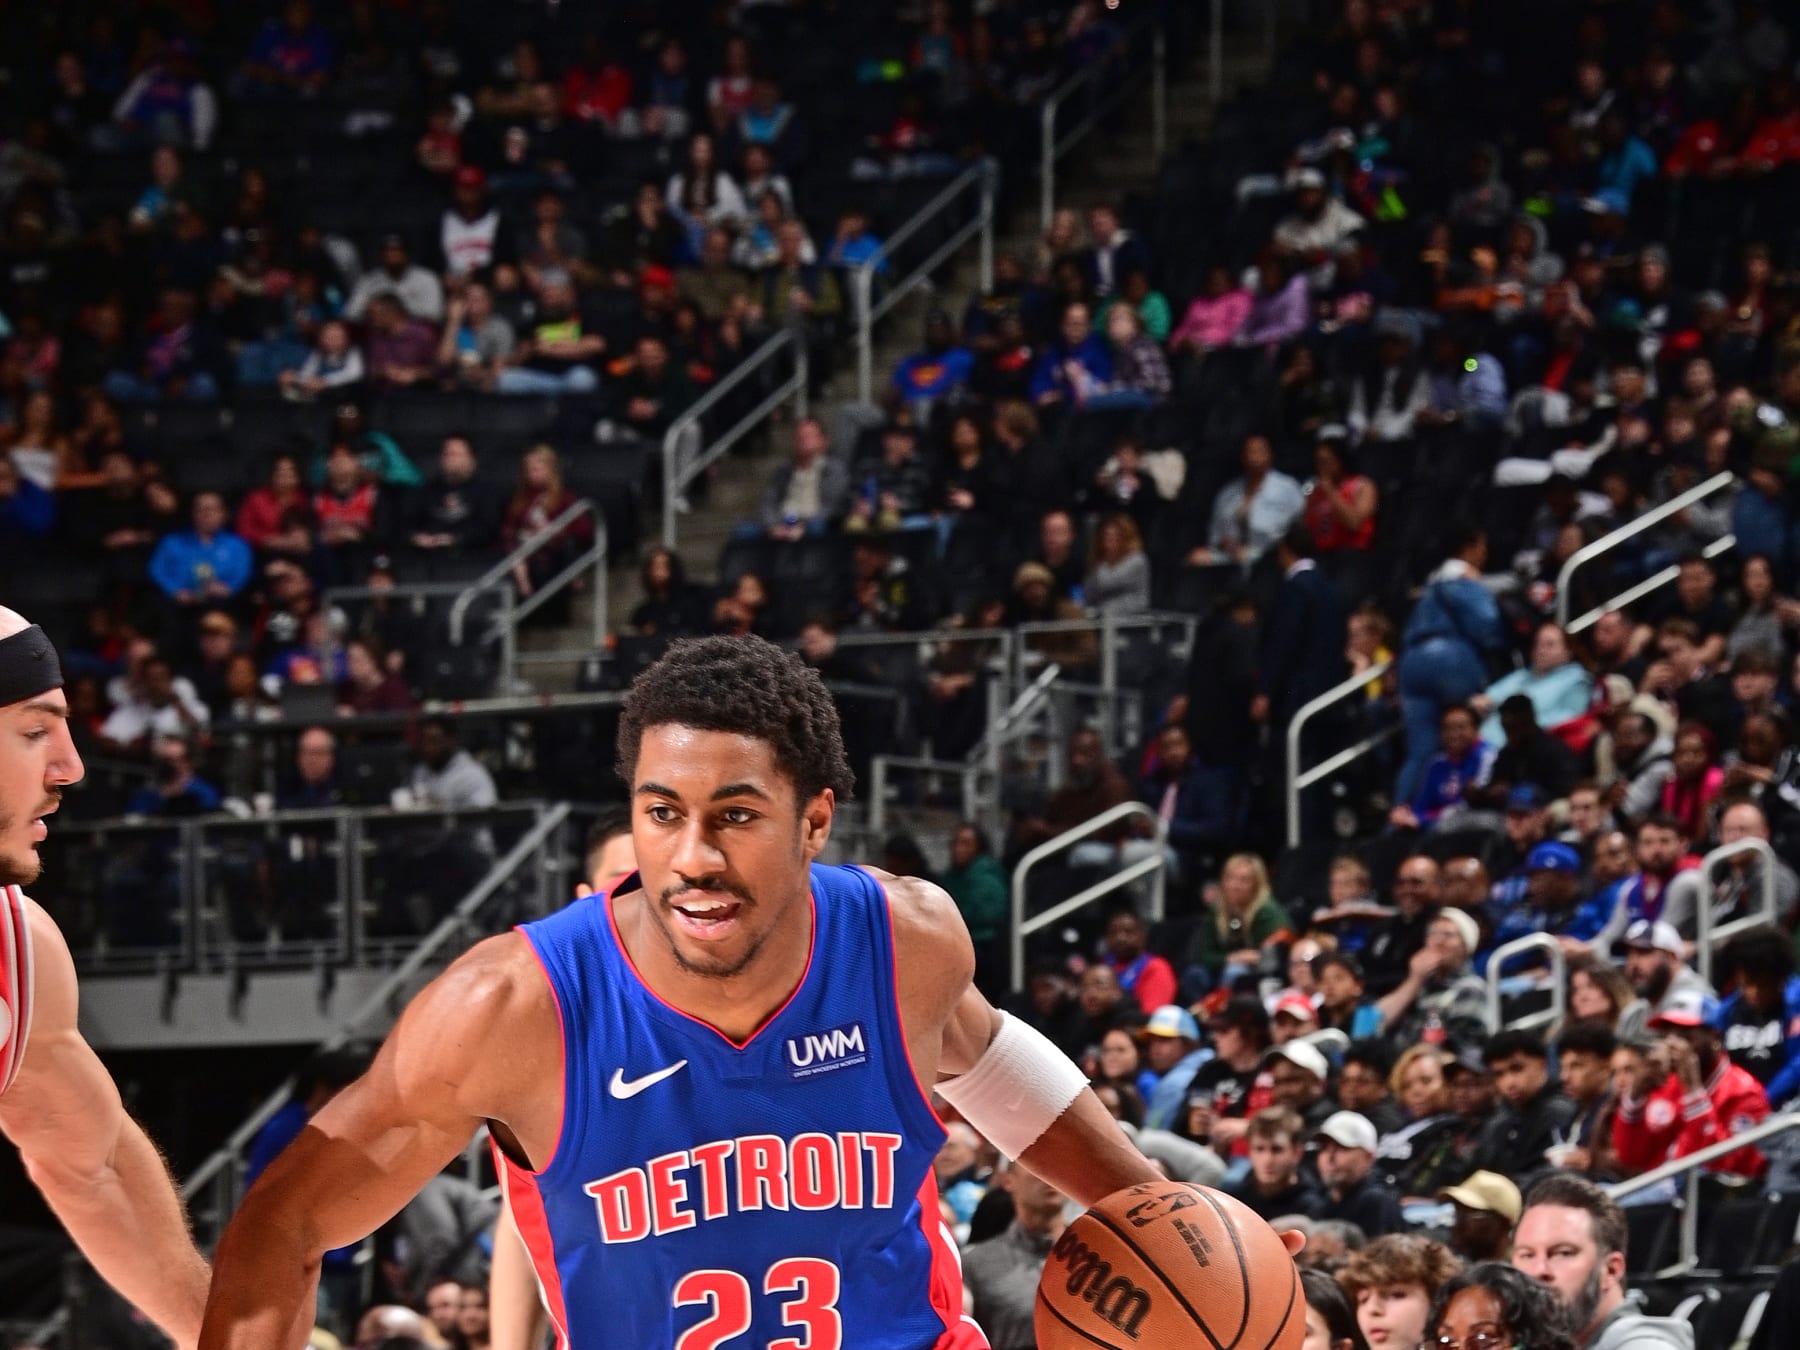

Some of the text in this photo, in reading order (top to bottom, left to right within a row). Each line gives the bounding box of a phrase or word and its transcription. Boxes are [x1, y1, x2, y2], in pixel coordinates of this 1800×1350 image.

[787, 1024, 865, 1067] UWM
[583, 1132, 902, 1244] DETROIT
[1052, 1232, 1153, 1342] Wilso
